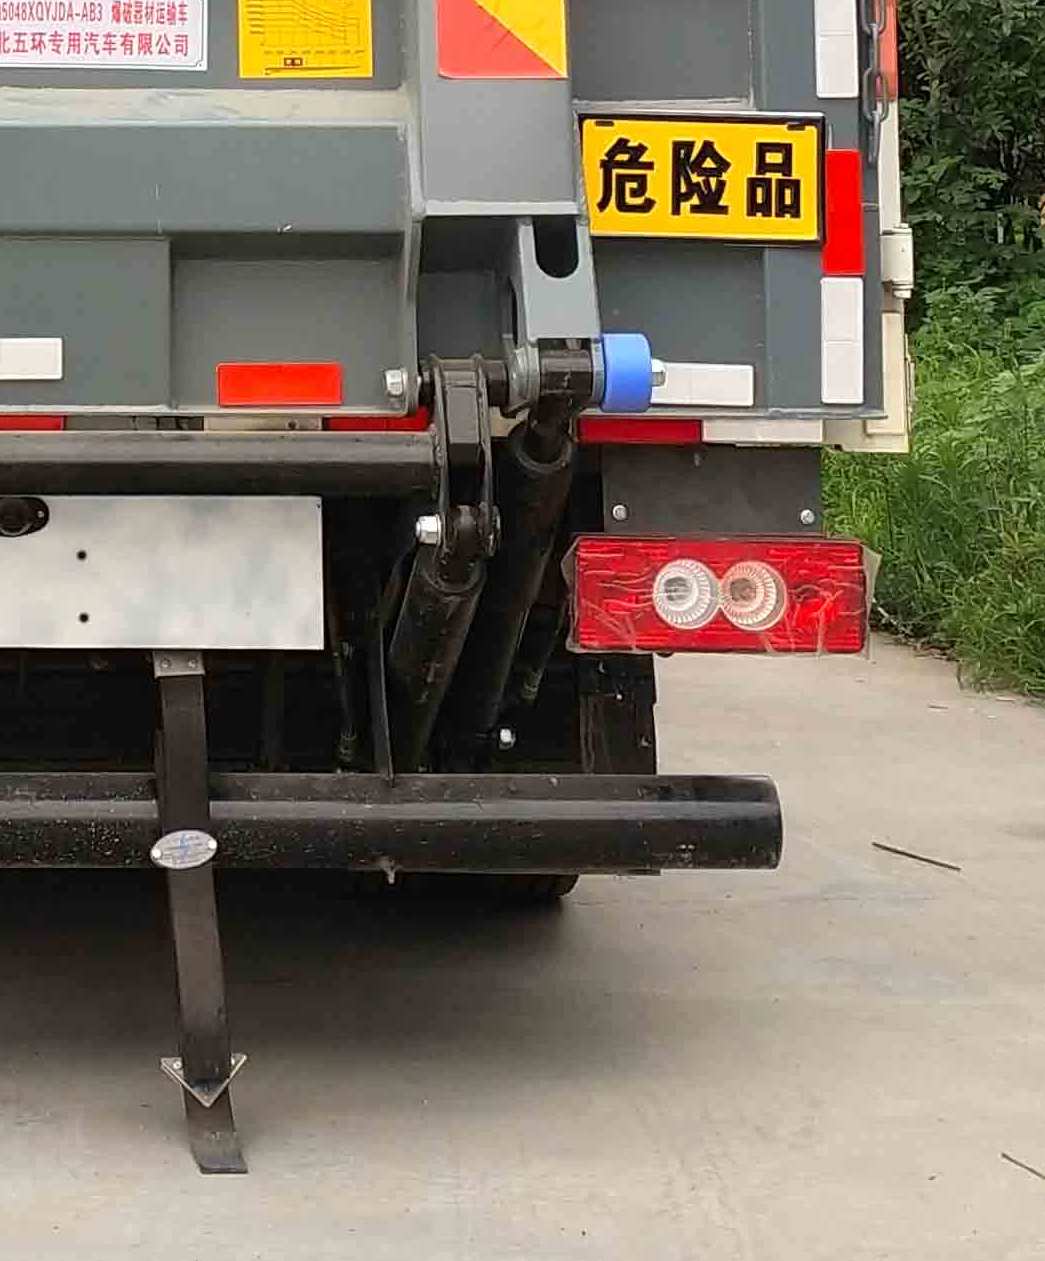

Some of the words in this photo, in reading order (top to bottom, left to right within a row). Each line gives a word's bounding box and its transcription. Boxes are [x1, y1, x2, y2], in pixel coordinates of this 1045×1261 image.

[110, 0, 189, 25] 爆破器材运输车
[596, 137, 802, 219] 危险品
